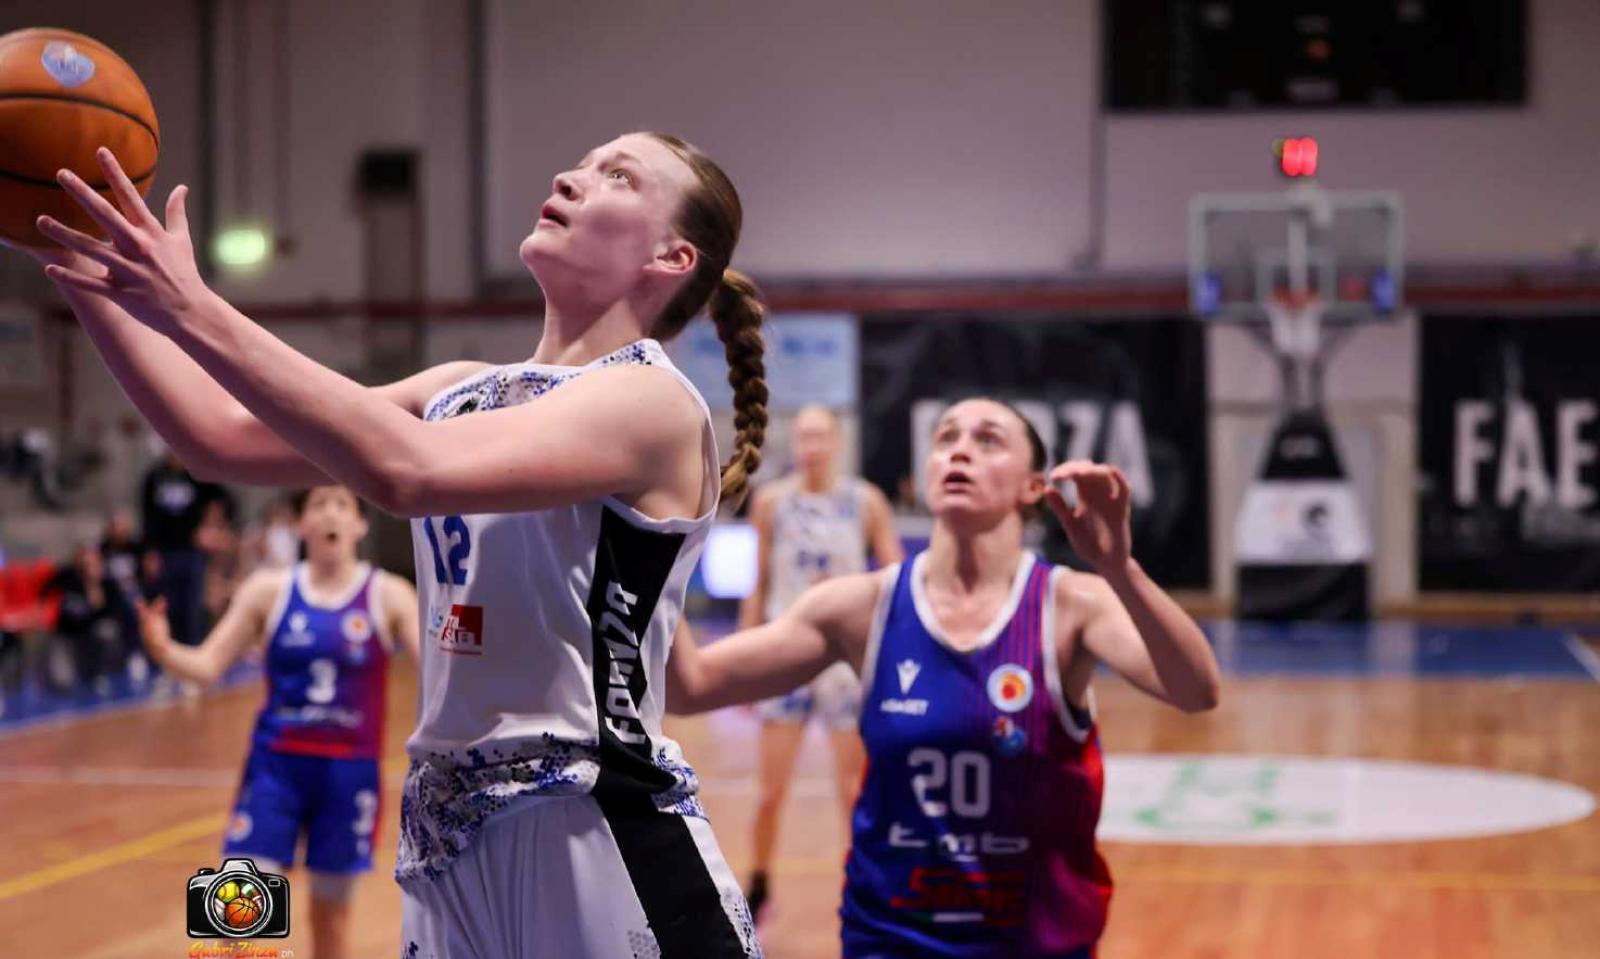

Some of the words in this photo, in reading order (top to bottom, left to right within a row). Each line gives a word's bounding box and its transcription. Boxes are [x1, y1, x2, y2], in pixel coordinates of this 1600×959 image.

[424, 516, 471, 585] 12
[306, 659, 337, 704] 3
[908, 748, 990, 818] 20
